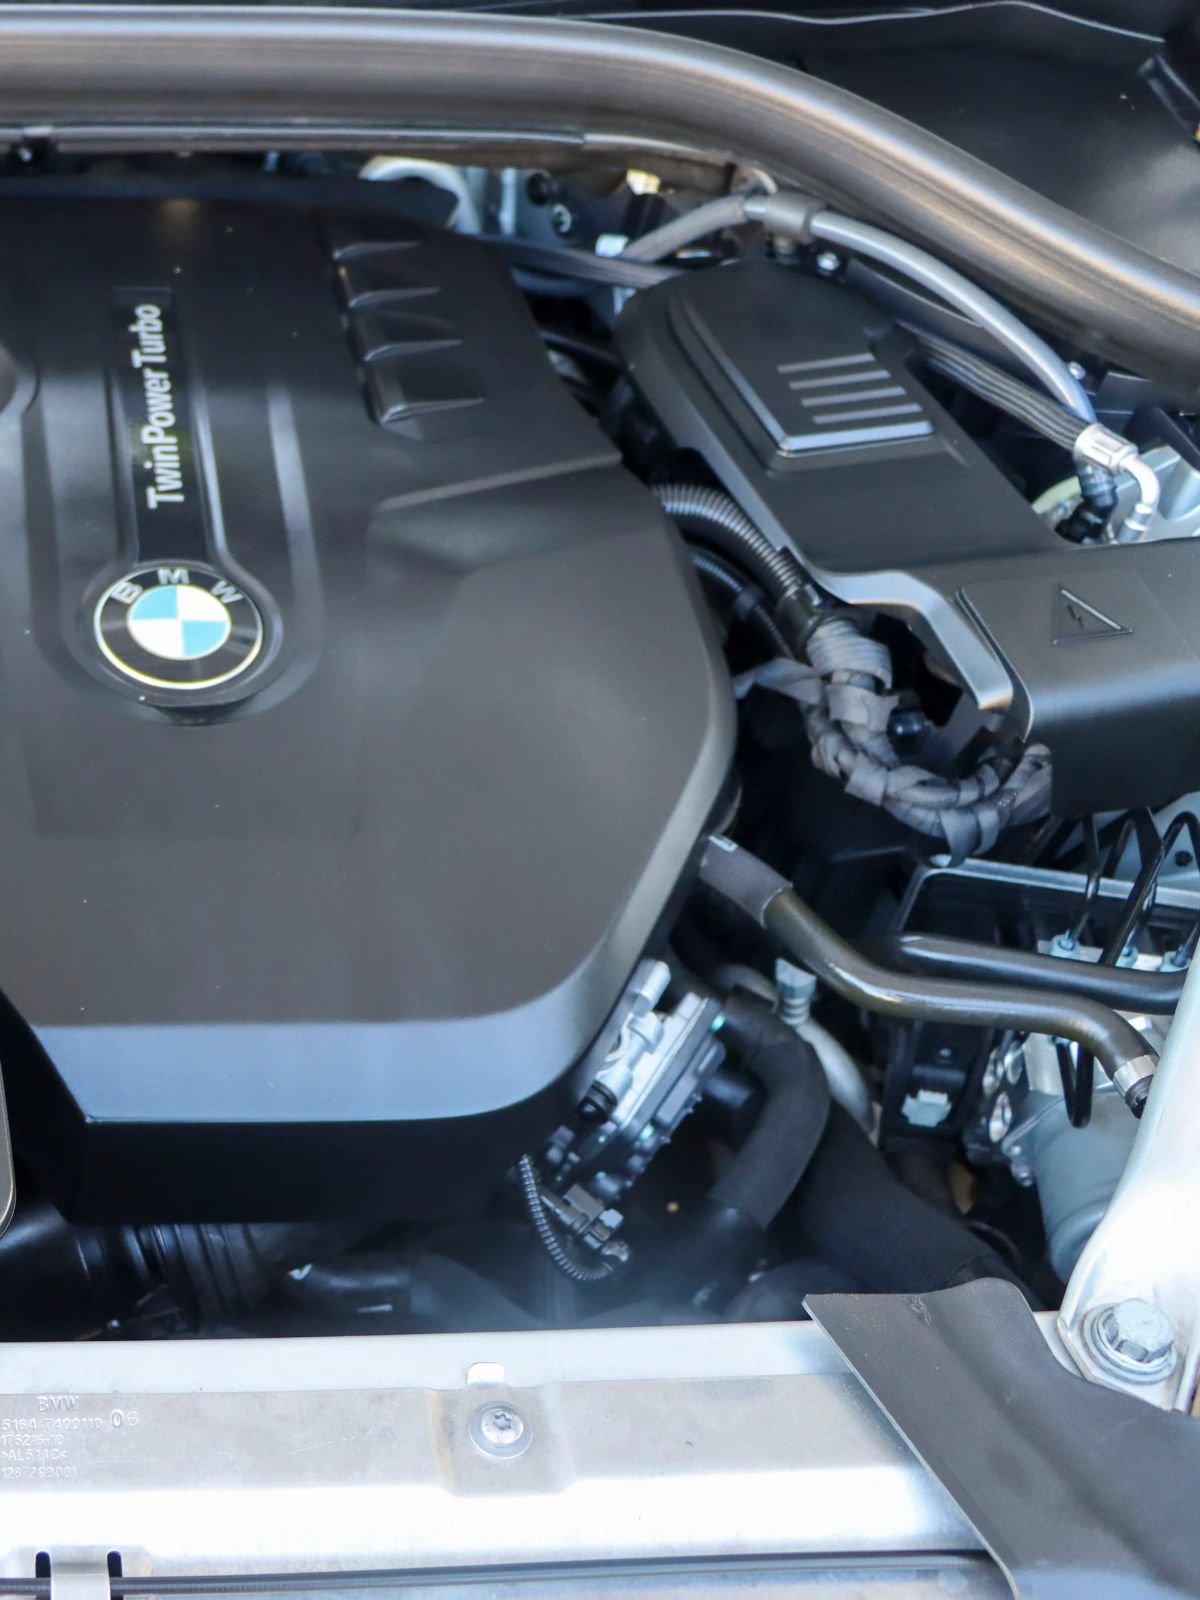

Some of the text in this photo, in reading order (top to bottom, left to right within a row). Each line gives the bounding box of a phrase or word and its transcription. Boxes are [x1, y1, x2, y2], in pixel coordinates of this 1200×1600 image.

[129, 303, 185, 510] TwinPower Turbo
[110, 567, 243, 605] BMW
[37, 1395, 80, 1413] BMW
